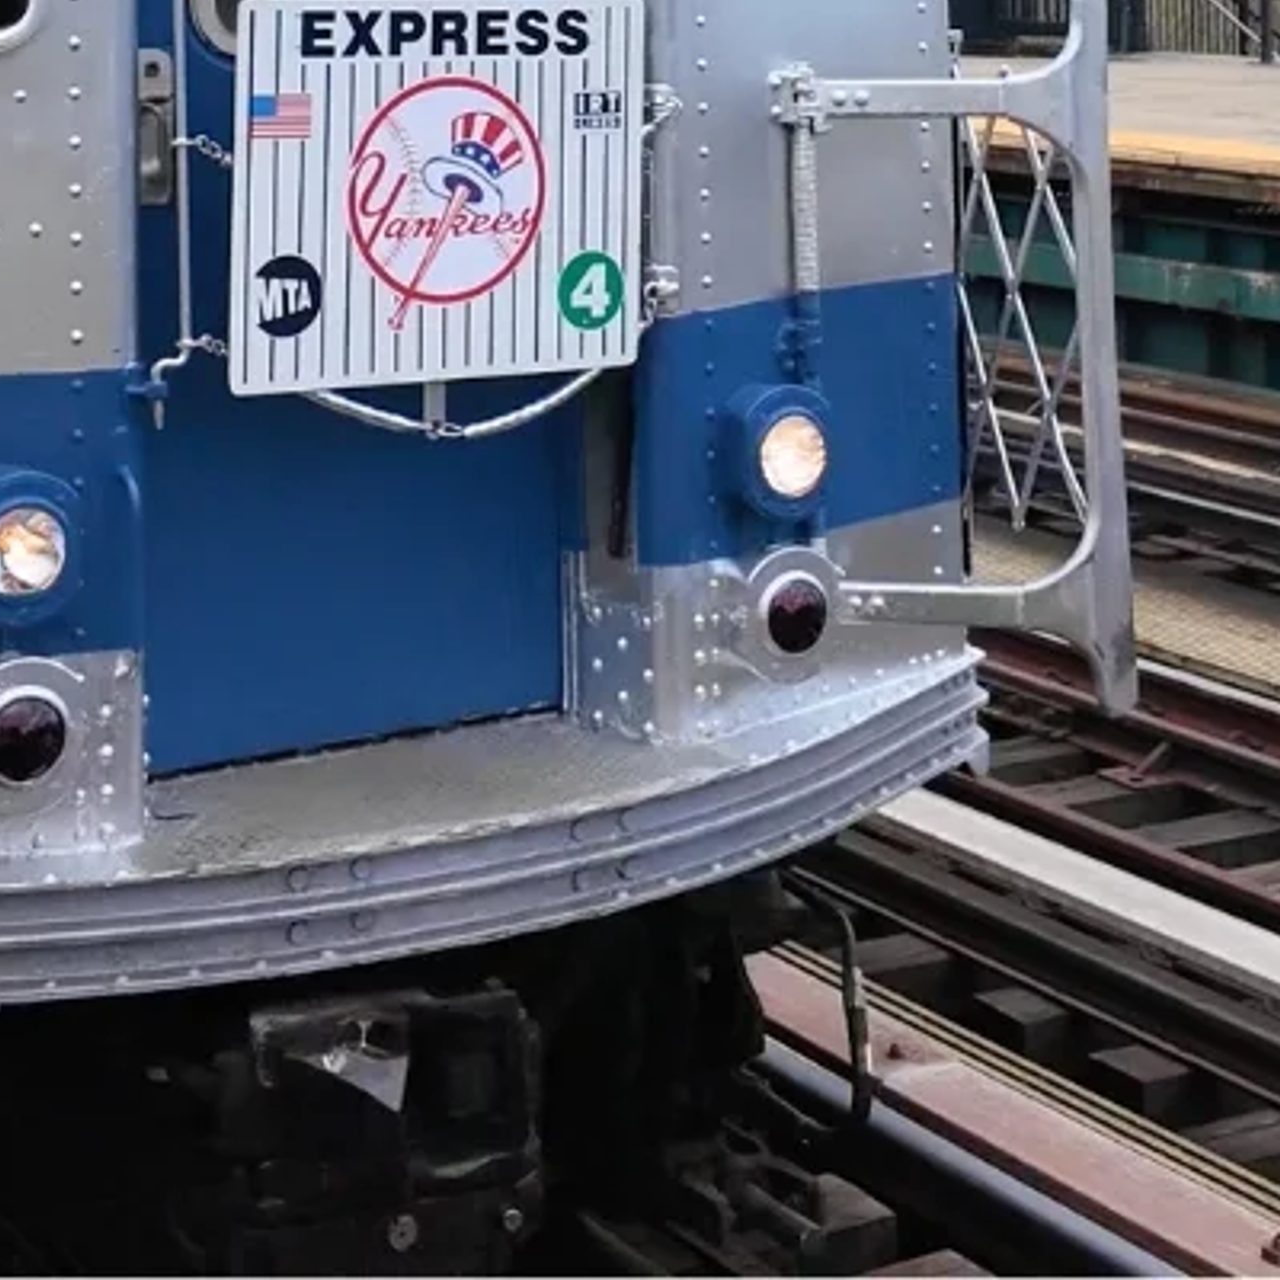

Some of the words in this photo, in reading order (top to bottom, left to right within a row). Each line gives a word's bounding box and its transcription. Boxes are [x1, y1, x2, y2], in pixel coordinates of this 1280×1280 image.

[301, 10, 591, 58] EXPRESS
[352, 151, 532, 247] Yankees
[257, 278, 312, 322] MTA
[571, 264, 611, 319] 4
